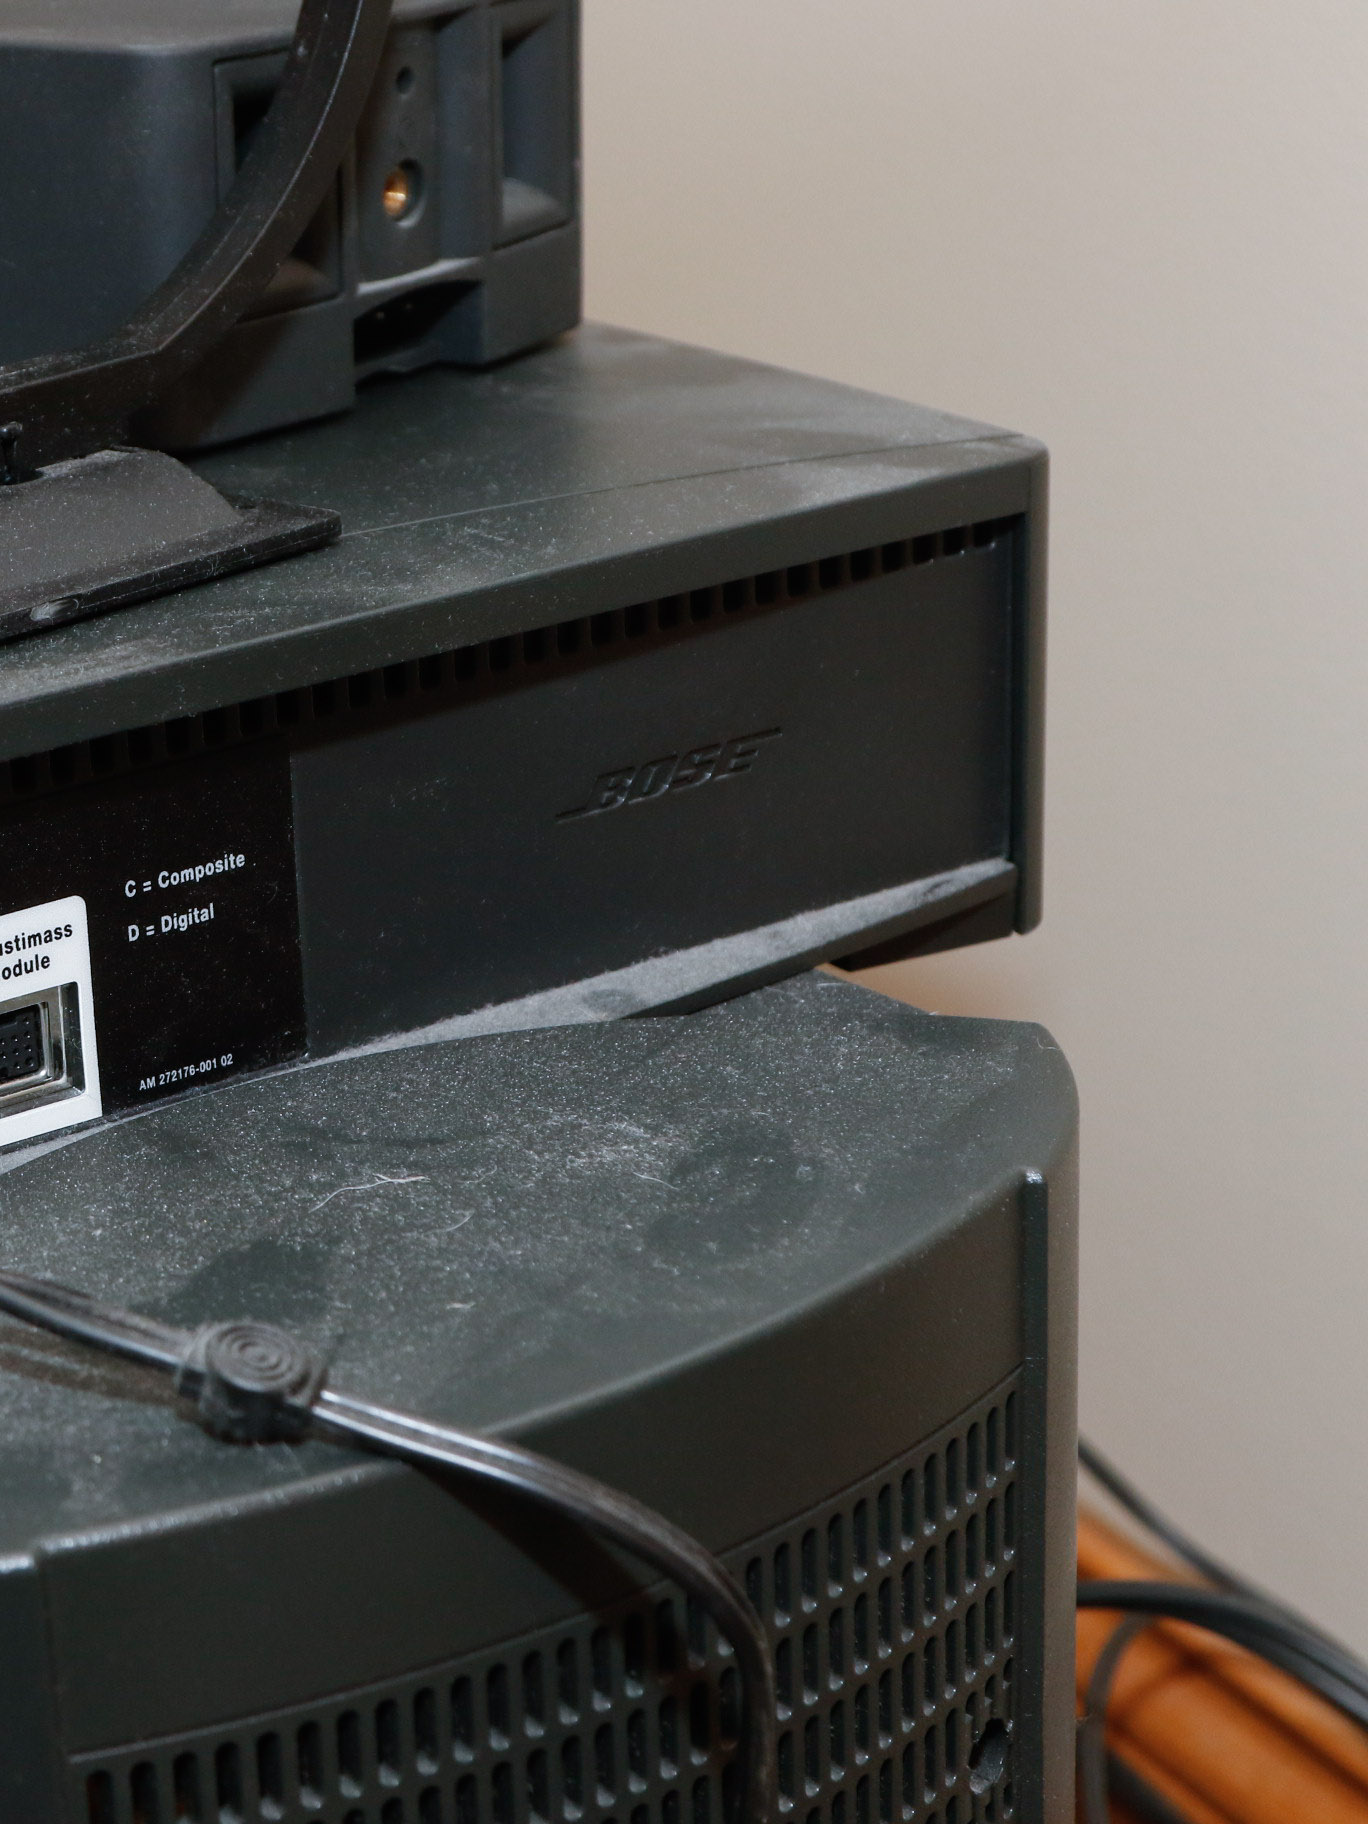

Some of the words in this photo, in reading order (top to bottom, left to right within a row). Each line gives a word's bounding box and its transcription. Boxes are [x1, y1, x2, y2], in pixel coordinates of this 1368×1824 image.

[555, 726, 782, 824] BOSE
[124, 880, 137, 898] C
[157, 852, 246, 890] Composite
[127, 925, 140, 942] D
[161, 903, 215, 934] Digital
[139, 1076, 156, 1091] AM
[159, 1059, 218, 1086] 272176-001
[220, 1053, 234, 1067] 02
